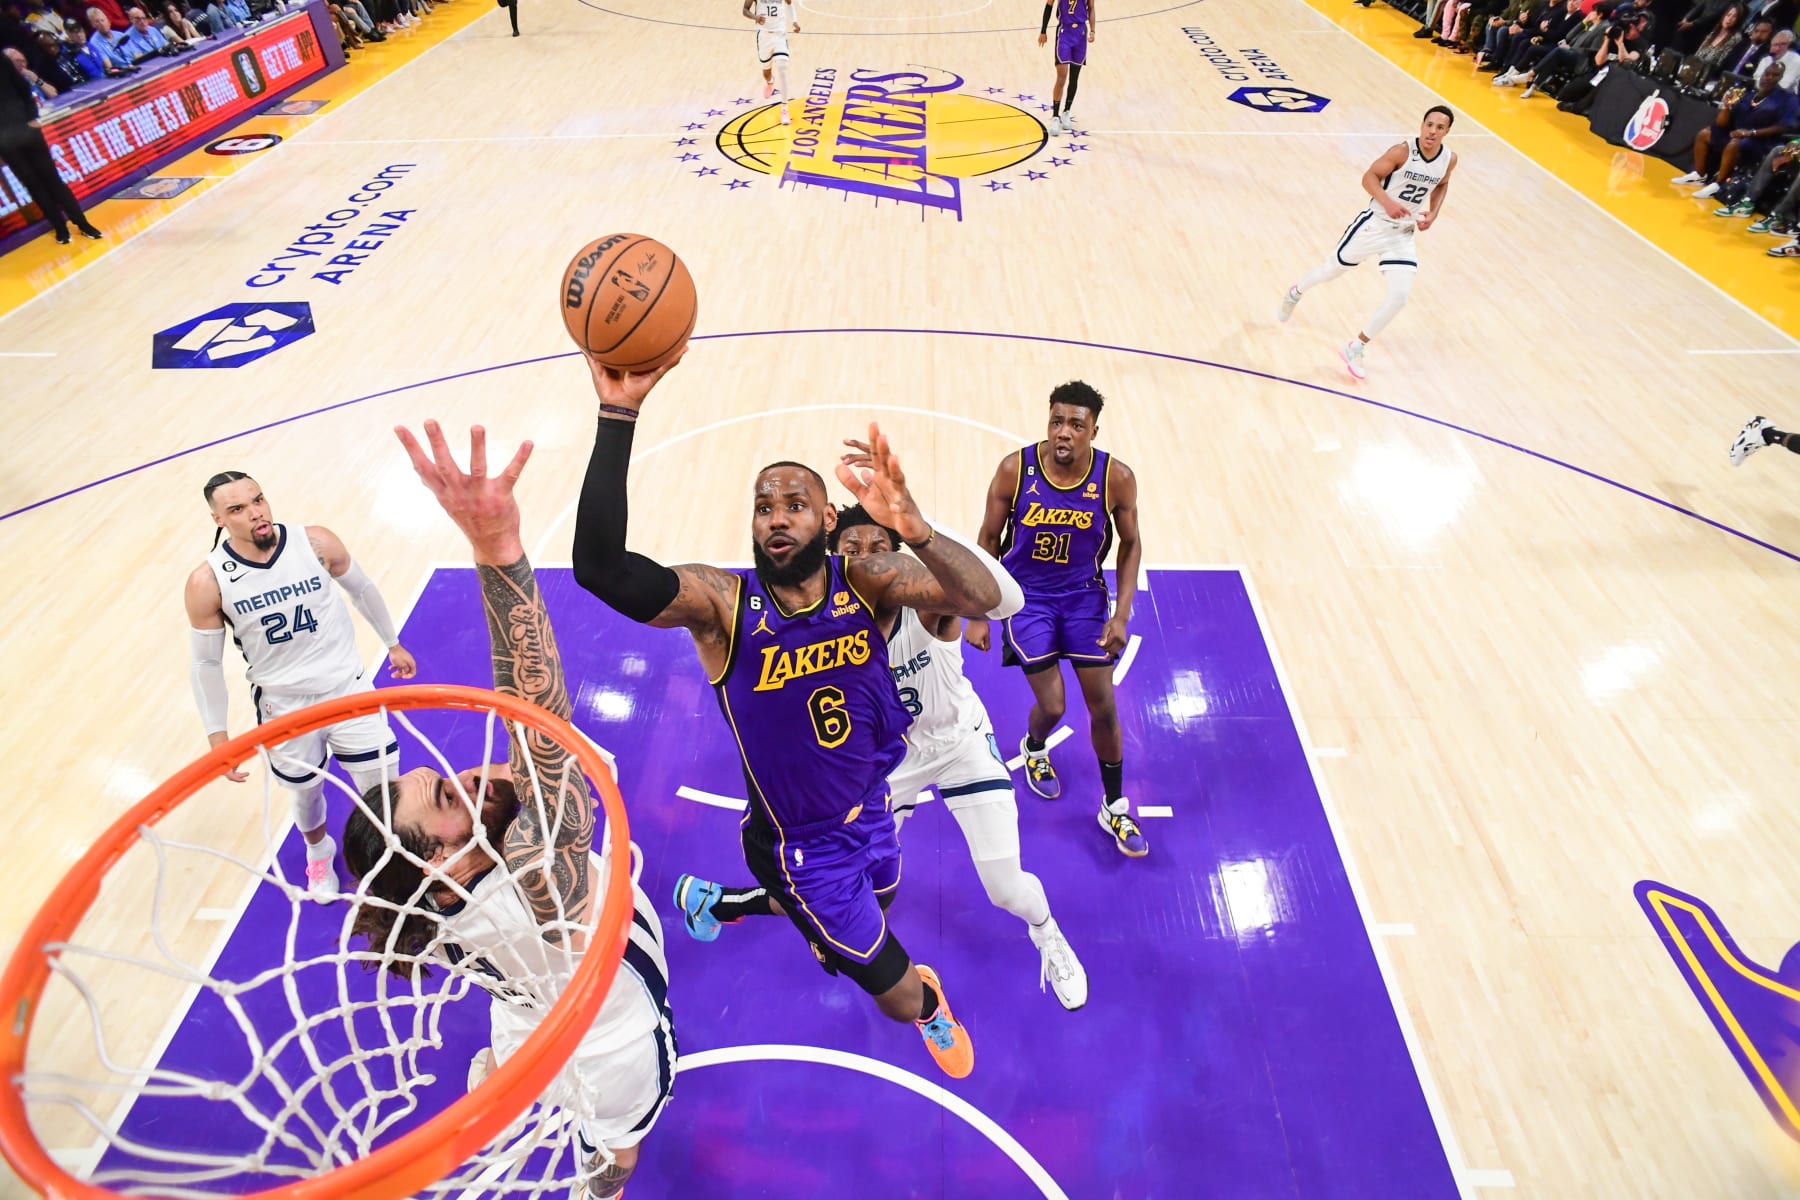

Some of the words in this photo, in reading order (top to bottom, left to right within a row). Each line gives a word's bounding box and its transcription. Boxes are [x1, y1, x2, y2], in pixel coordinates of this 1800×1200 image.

[766, 6, 778, 17] 12
[260, 44, 286, 80] GET
[278, 37, 304, 72] THE
[295, 29, 317, 63] APP
[1239, 48, 1294, 82] ARENA
[802, 67, 838, 127] ANGELES
[68, 131, 109, 175] ALL
[93, 116, 135, 161] THE
[121, 102, 167, 148] TIME
[154, 95, 180, 133] IS
[168, 67, 239, 126] HAPPENING
[778, 63, 965, 223] LAKERS
[790, 127, 822, 158] LOS
[1398, 183, 1428, 204] 22
[310, 208, 417, 285] ARENA
[566, 235, 629, 308] Wilson
[1027, 466, 1035, 476] 6
[1021, 502, 1094, 529] LAKERS
[1032, 531, 1071, 564] 31
[233, 576, 322, 615] MEMPHIS
[750, 596, 762, 610] 6
[831, 602, 861, 618] bibigo
[261, 603, 318, 645] 24
[753, 629, 871, 692] LAKERS
[891, 649, 931, 683] PHIS
[807, 685, 852, 749] 6
[899, 687, 923, 717] 3
